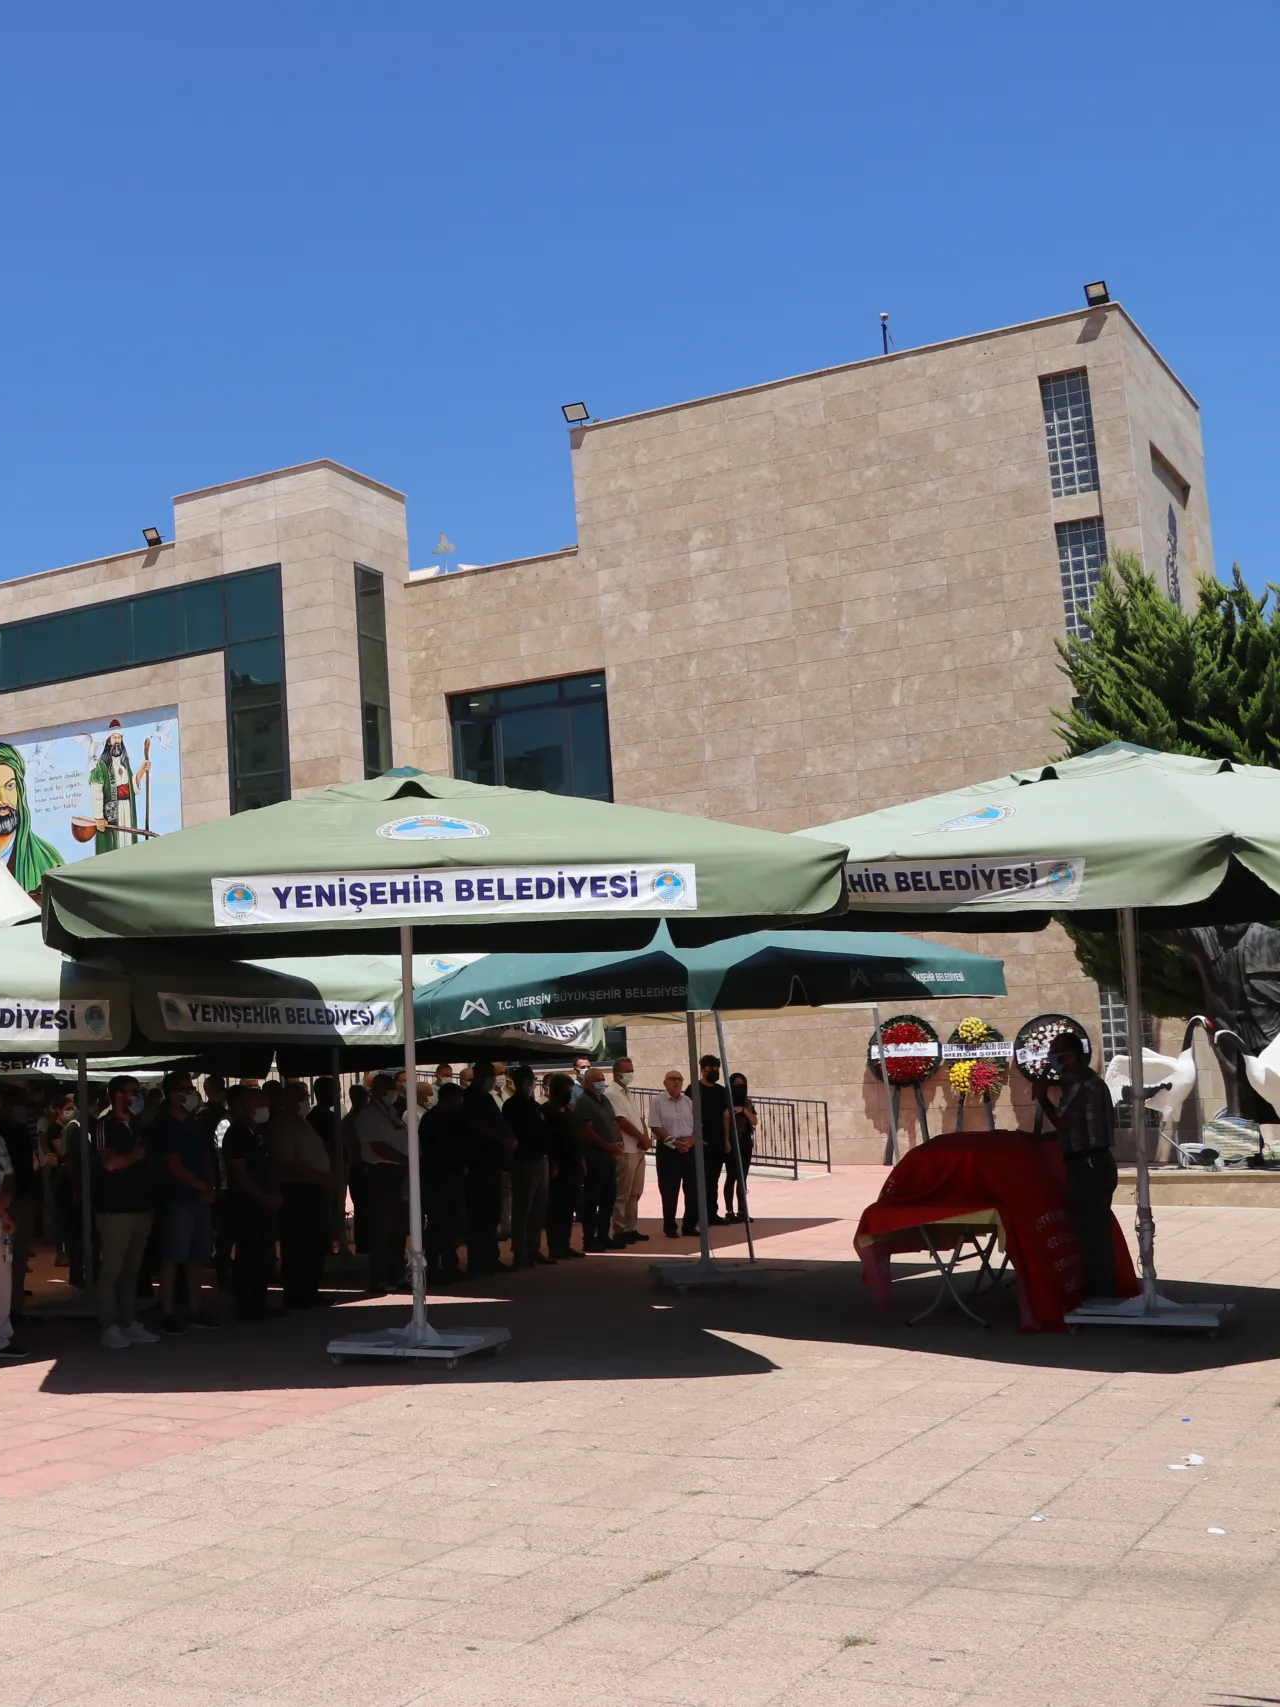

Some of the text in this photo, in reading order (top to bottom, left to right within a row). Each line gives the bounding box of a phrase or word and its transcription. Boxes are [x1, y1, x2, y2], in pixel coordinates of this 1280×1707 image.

[272, 874, 443, 913] YENİŞEHİR
[454, 870, 639, 902] BELEDİYESİ
[847, 868, 890, 892] HİR
[894, 862, 1039, 893] BELEDİYESİ
[497, 983, 689, 1011] T.C. MERSİN BÜYÜKŞEHİR BELEDİYESİ
[187, 1000, 375, 1029] YENİŞEHİR BELEDİYESİ
